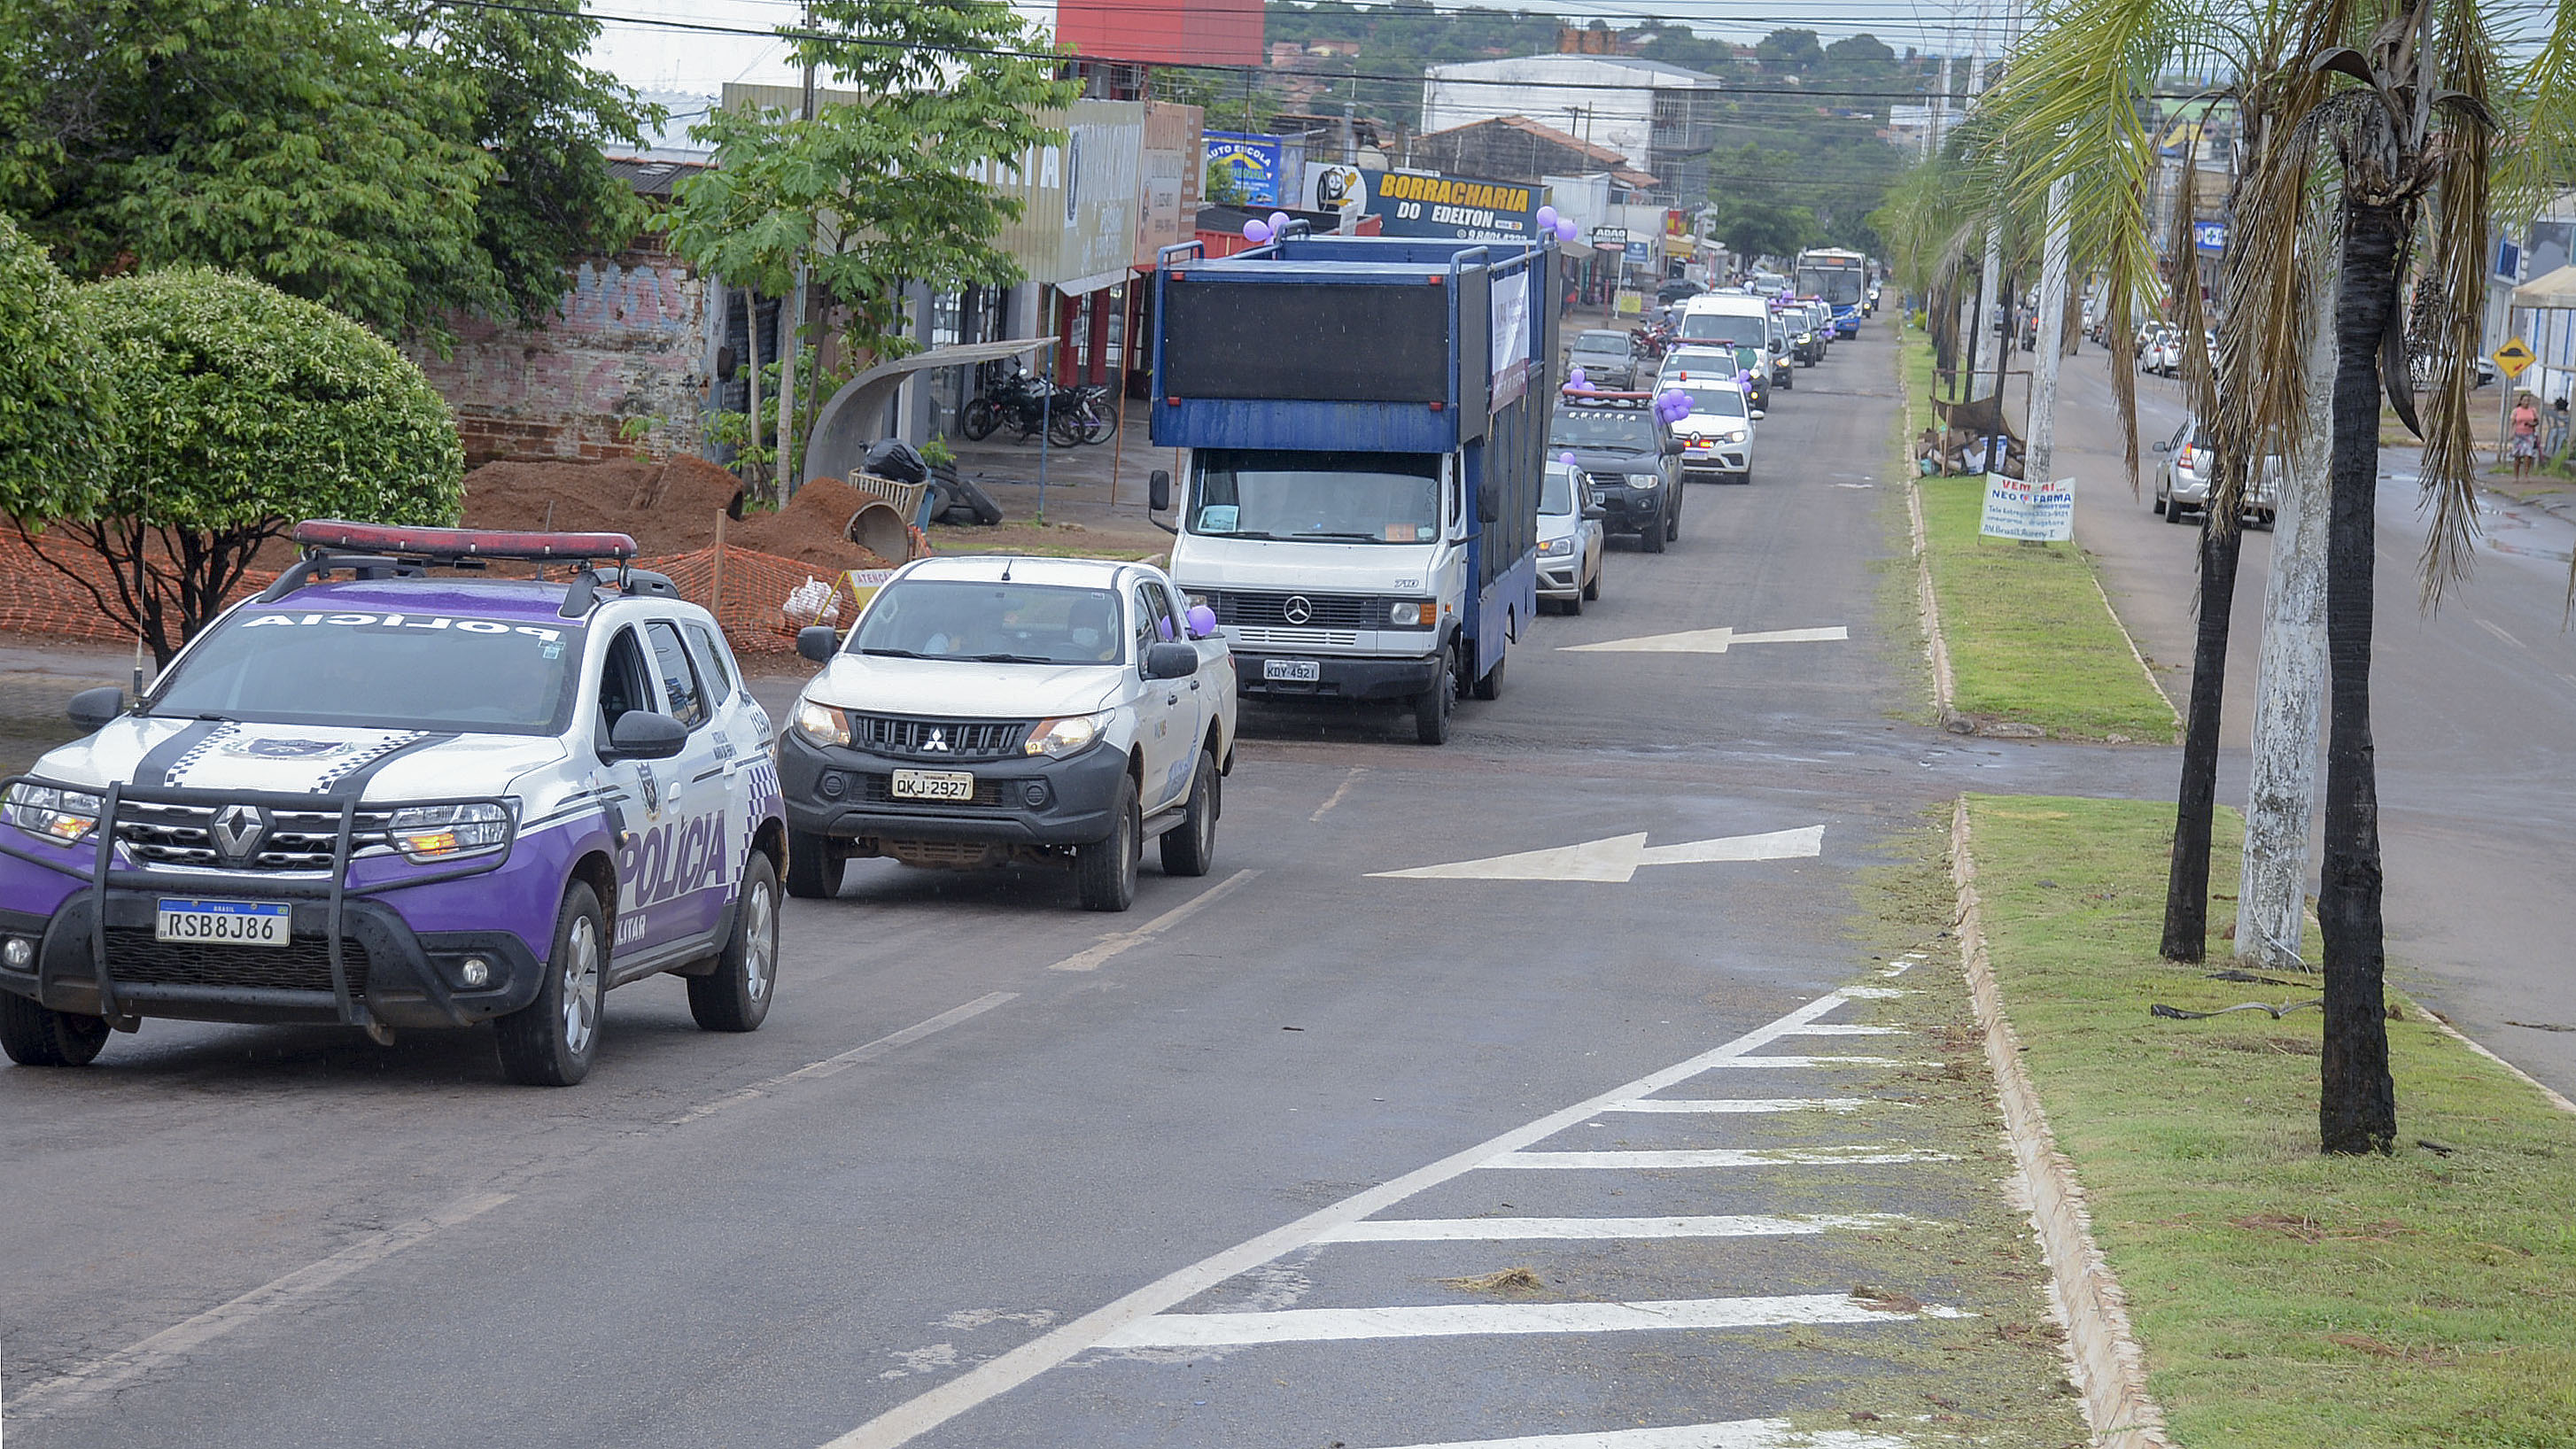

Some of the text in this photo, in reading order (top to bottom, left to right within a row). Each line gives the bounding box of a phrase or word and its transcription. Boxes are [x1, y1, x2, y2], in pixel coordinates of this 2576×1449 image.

[1379, 174, 1529, 213] BORRACHARIA
[1397, 202, 1494, 229] DO EDELTON
[1992, 490, 2071, 503] NEO FARMA
[2003, 479, 2031, 492] VEM
[620, 810, 727, 908] POLÍCIA
[168, 913, 275, 940] RSB8J86
[615, 914, 647, 946] LITAR
